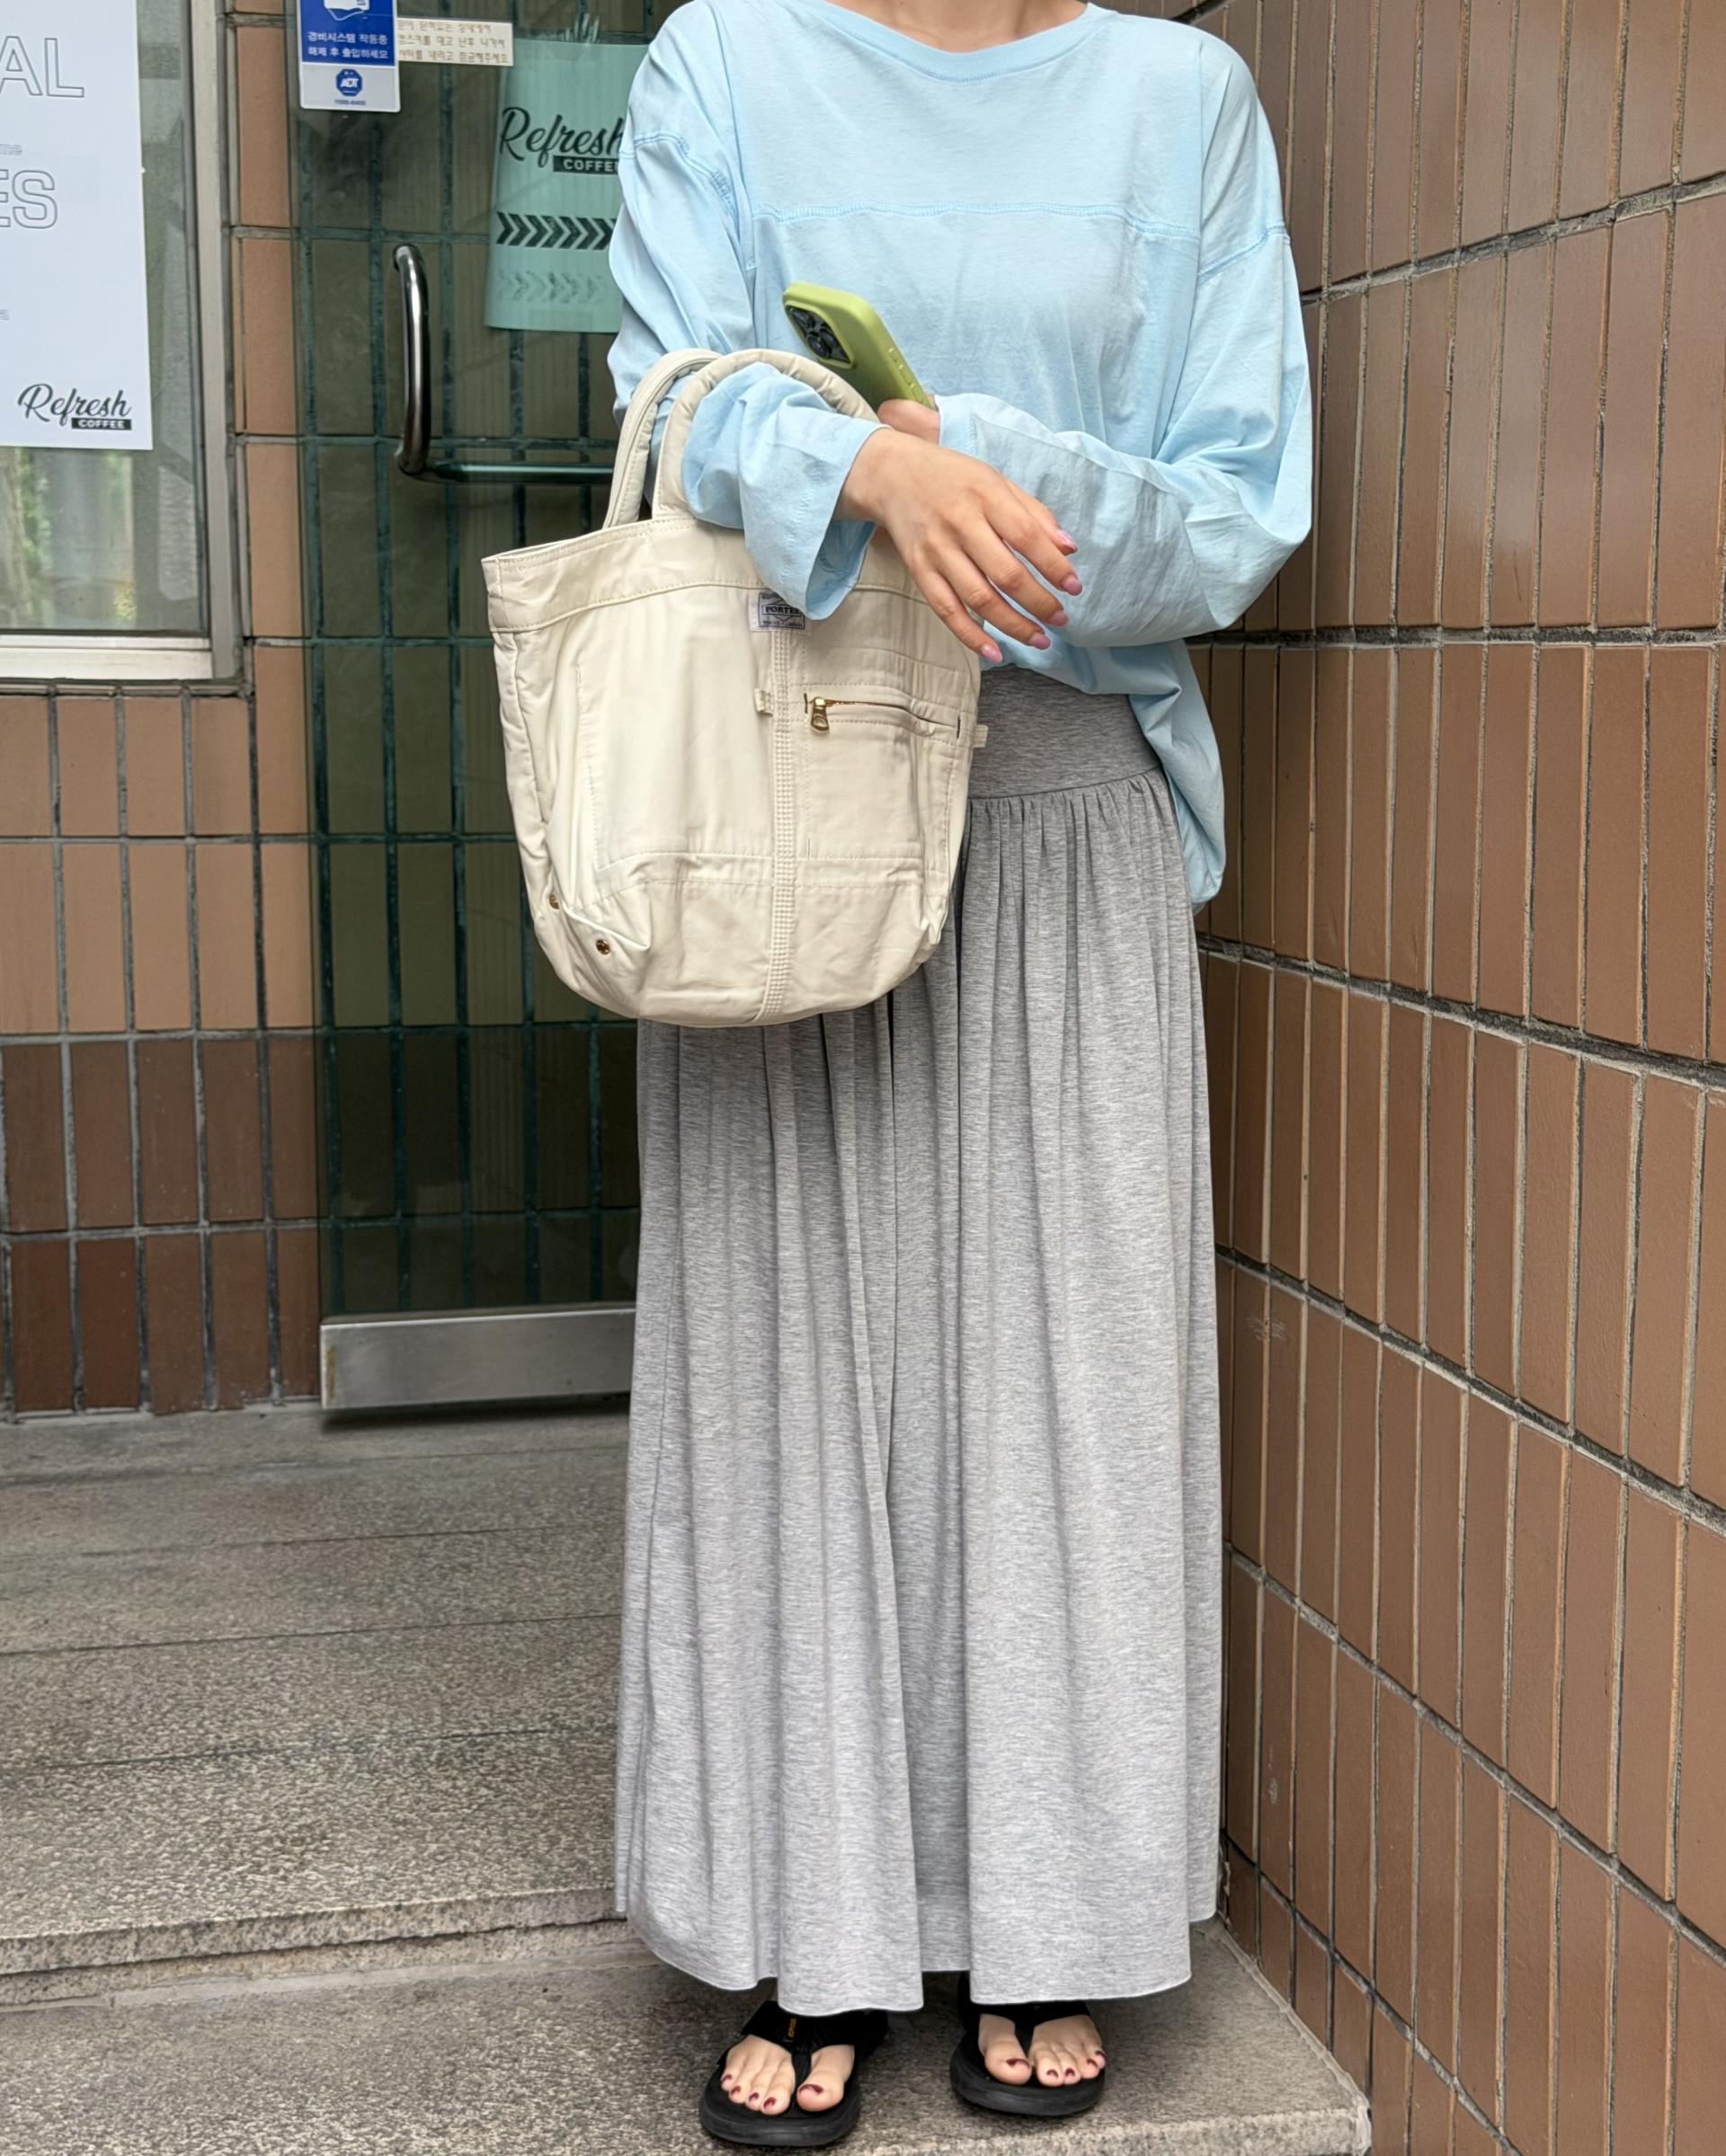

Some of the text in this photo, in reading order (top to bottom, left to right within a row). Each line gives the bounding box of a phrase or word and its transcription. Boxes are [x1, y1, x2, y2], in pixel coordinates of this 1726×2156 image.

[307, 31, 388, 45] 경비시스템 작동중
[308, 46, 388, 58] 해제 후 출입하세요
[499, 107, 624, 168] Refresh
[17, 383, 132, 427] Refresh
[78, 419, 126, 430] COFFEE
